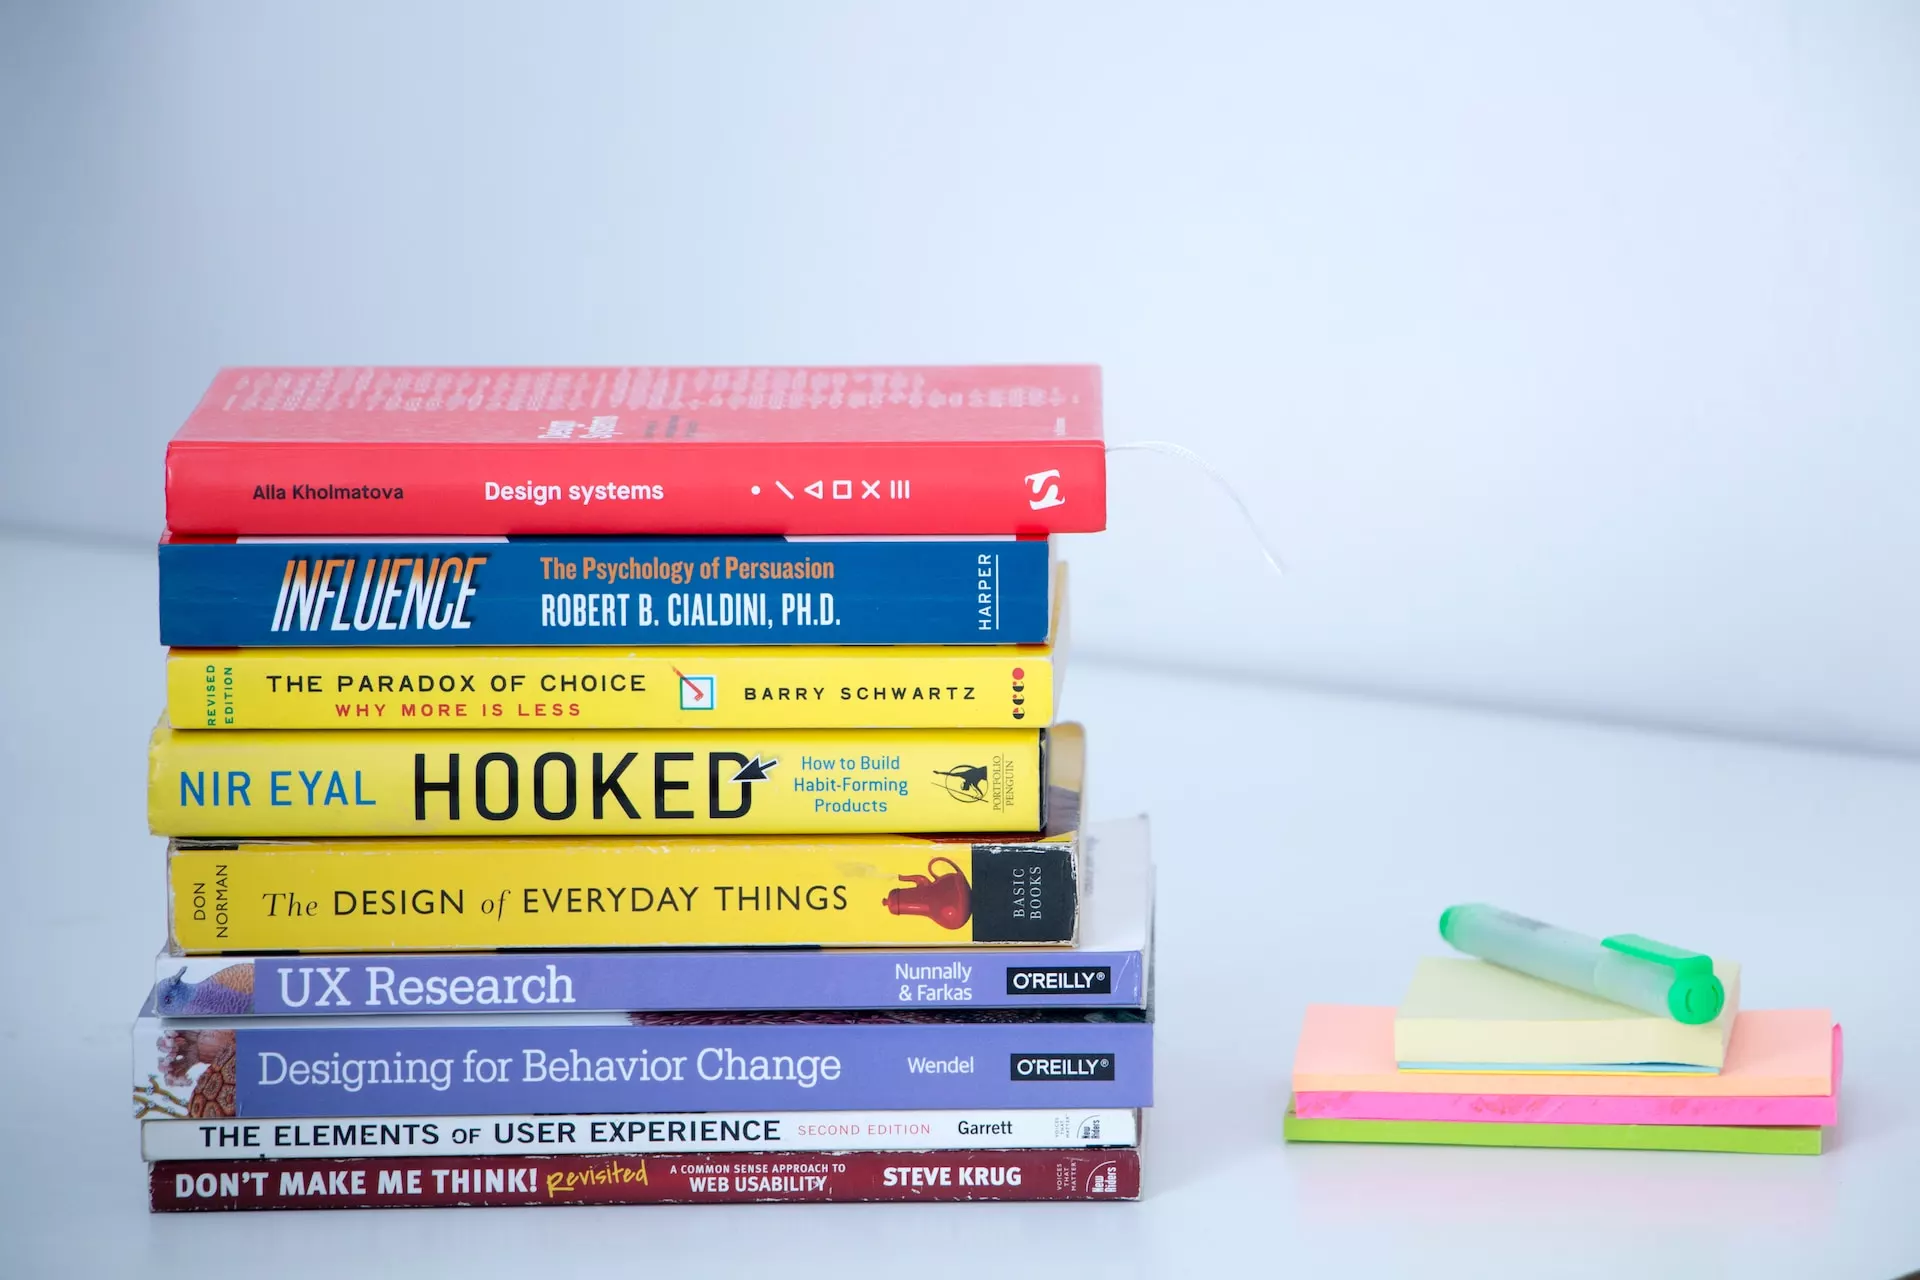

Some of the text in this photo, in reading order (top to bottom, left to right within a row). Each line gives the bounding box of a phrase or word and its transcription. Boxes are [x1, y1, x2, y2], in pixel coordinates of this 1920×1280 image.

[253, 485, 403, 500] Alla Kholmatova
[486, 481, 663, 505] Design systems
[540, 556, 834, 584] The Psychology of Persuasion
[270, 557, 487, 631] INFLUENCE
[978, 555, 991, 630] HARPER
[542, 593, 840, 629] ROBERT B. CIALDINI, PH.D.
[207, 664, 216, 725] REVISED
[224, 668, 233, 724] EDITION
[266, 675, 645, 692] THE PARADOX OF CHOICE
[745, 687, 974, 700] BARRY SCHWARTZ
[336, 704, 579, 716] WHY MORE IS LESS
[801, 755, 899, 771] How to Build
[181, 771, 376, 806] NIR EYAL
[414, 751, 753, 821] HOOKED
[795, 777, 908, 796] Habit-Forming
[992, 755, 1001, 811] PORTFOLIO
[1005, 760, 1014, 806] PENGUIN
[815, 799, 887, 812] Products
[194, 883, 205, 920] DON
[216, 865, 228, 937] NORMAN
[263, 885, 847, 921] The DESIGN of EVERYDAY THINGS
[1013, 869, 1024, 917] BASIC
[1030, 867, 1041, 919] BOOKS
[278, 965, 576, 1007] UX Research
[896, 962, 972, 983] Nunnally
[899, 984, 972, 1001] & Farkas
[259, 1048, 841, 1092] Designing for Behavior Change
[908, 1056, 973, 1073] Wendel
[200, 1119, 781, 1148] THE ELEMENTS OF USER EXPERIENCE
[798, 1125, 929, 1135] SECOND EDITION
[959, 1121, 1012, 1134] Garrett
[176, 1168, 537, 1197] DON'T MAKE ME THINK!
[670, 1164, 845, 1174] A COMMON SENSE APPROACH TO
[883, 1167, 1021, 1186] STEVE KRUG
[1104, 1167, 1117, 1192] Riders
[689, 1176, 827, 1192] WEB USABILITY
[1092, 1175, 1104, 1192] New
